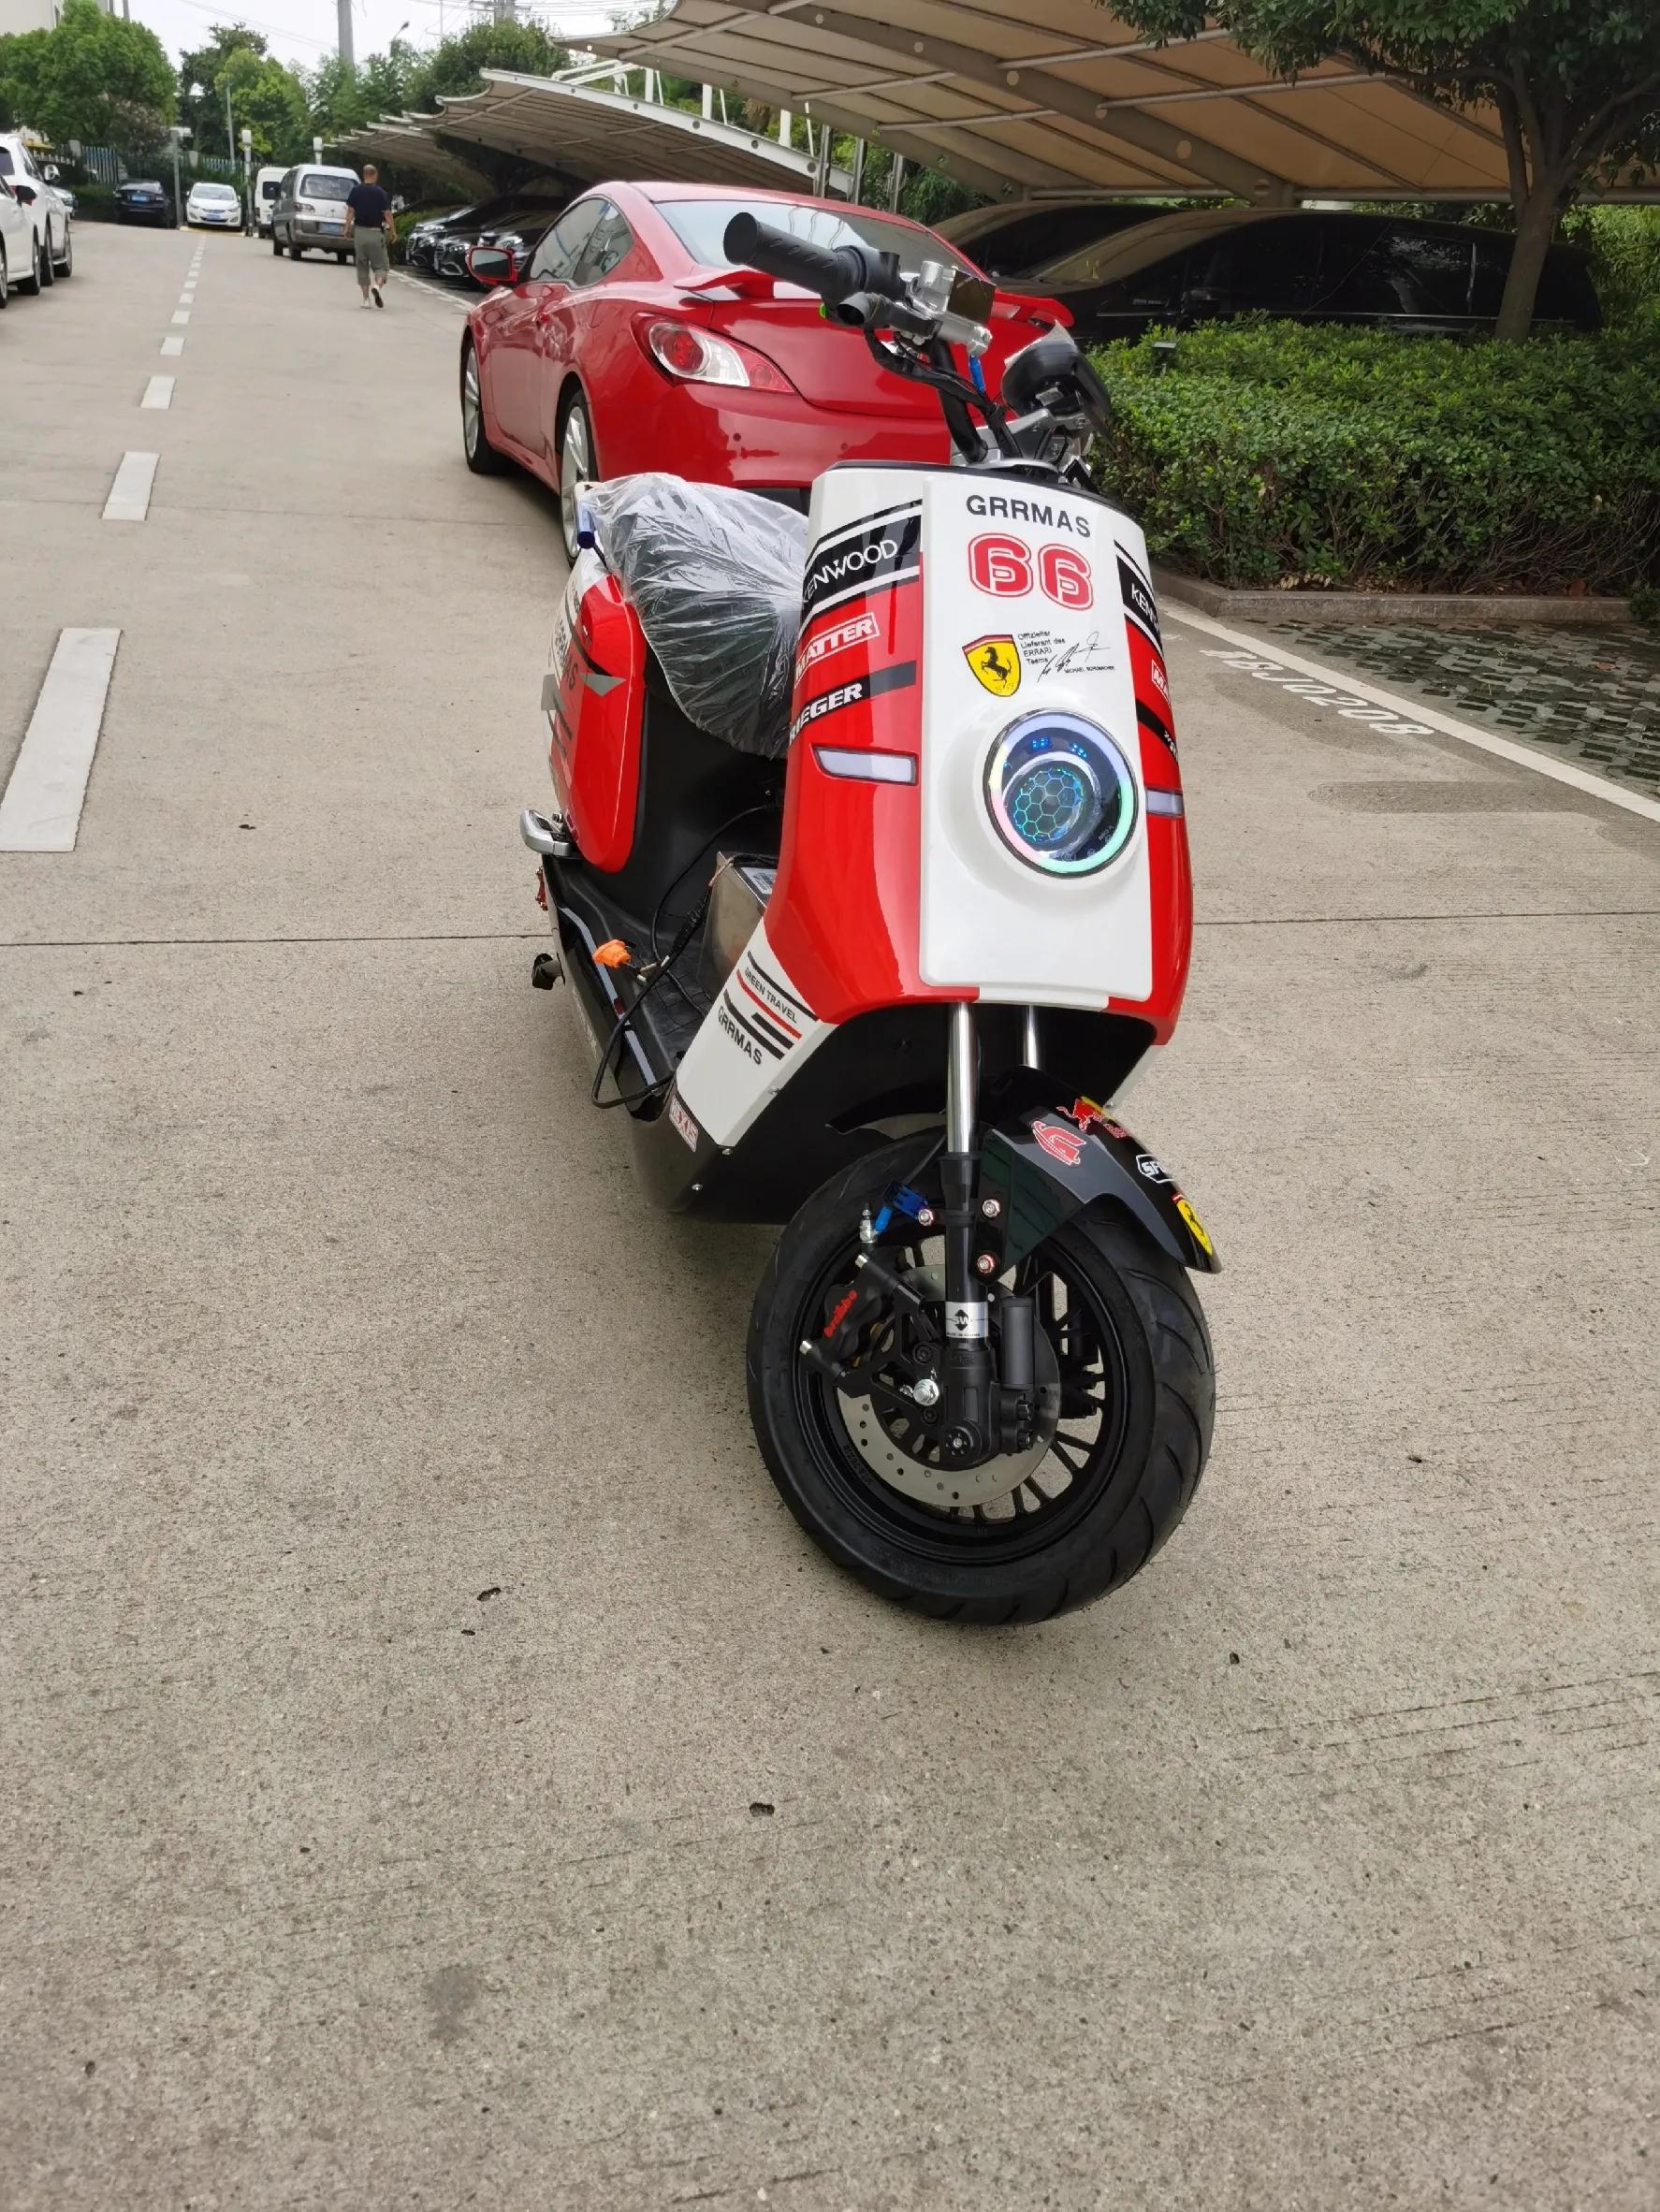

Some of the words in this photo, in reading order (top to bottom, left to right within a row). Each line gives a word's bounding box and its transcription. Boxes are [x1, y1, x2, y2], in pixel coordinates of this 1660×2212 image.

[966, 494, 1091, 538] GRRMAS
[968, 532, 1094, 611] 66
[795, 618, 873, 682] MATTER
[789, 682, 863, 746] RIEGER
[744, 967, 766, 996] GREEN
[766, 990, 797, 1025] TRAVEL
[718, 1005, 763, 1066] GRRMAS
